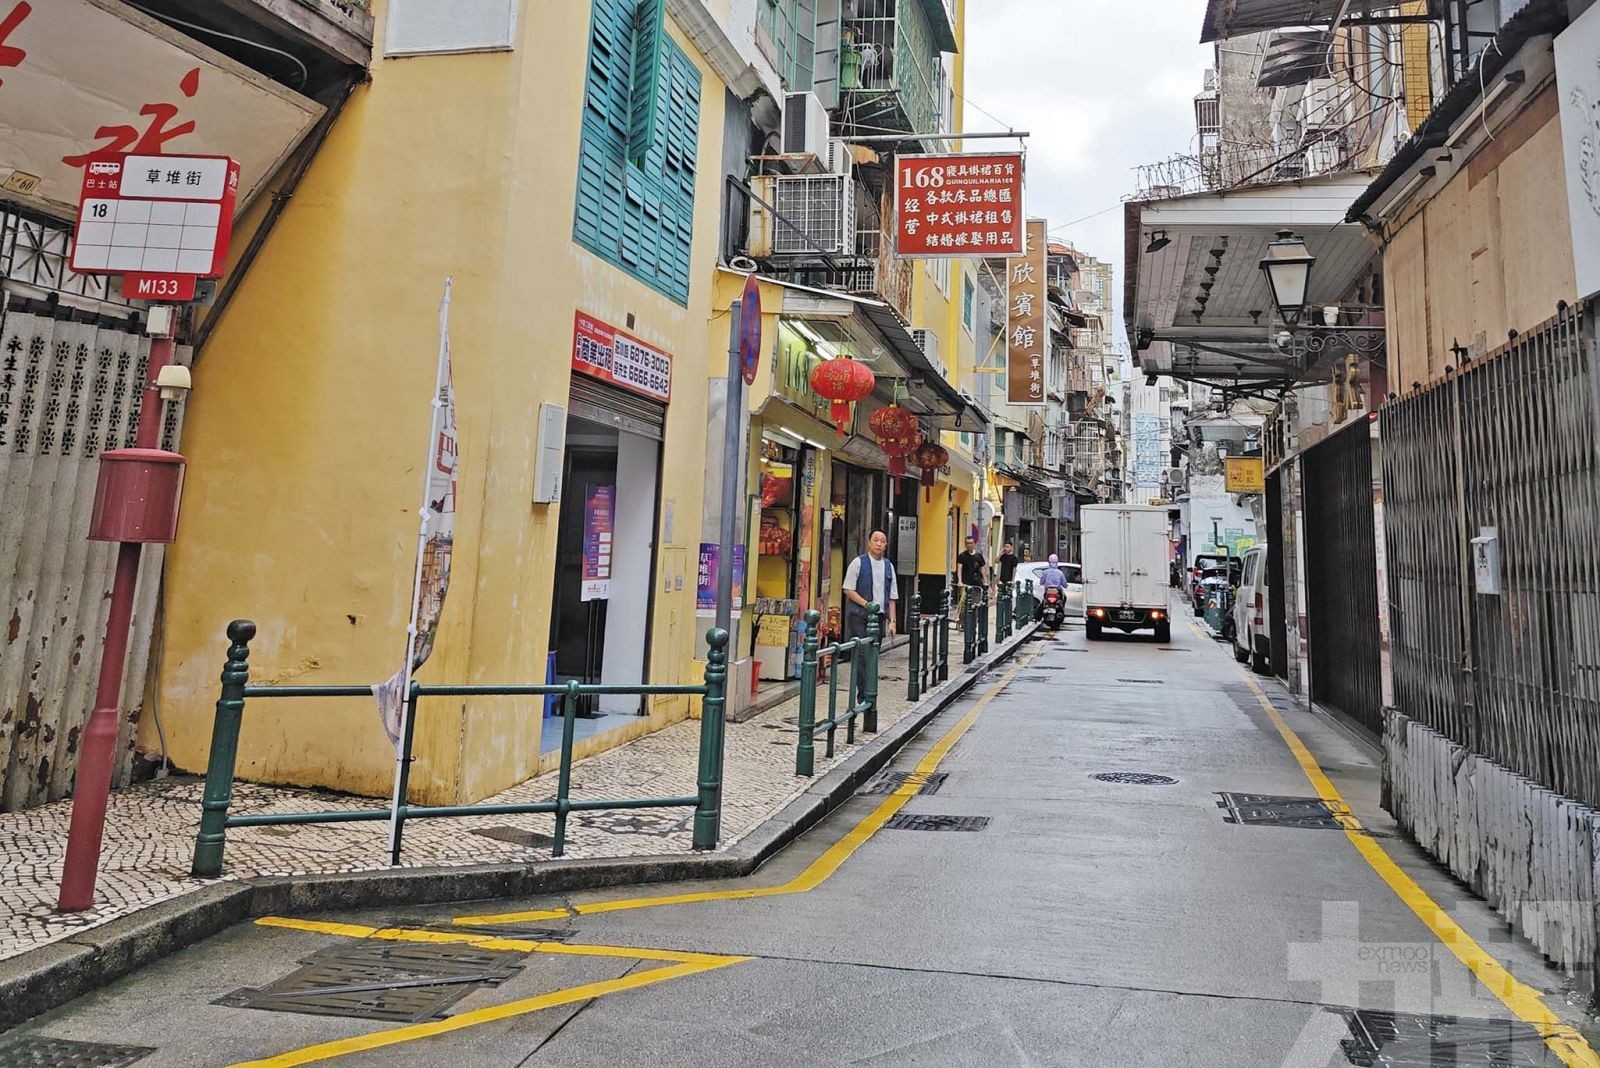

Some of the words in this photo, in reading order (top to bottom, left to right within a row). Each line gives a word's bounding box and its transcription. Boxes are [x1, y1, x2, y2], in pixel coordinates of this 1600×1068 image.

[86, 179, 118, 190] 巴士站
[146, 169, 202, 186] 草堆街
[902, 166, 944, 188] 168
[924, 188, 1012, 205] 各款床品總匯
[92, 203, 108, 218] 18
[904, 197, 920, 235] 经营
[138, 279, 179, 295] M133
